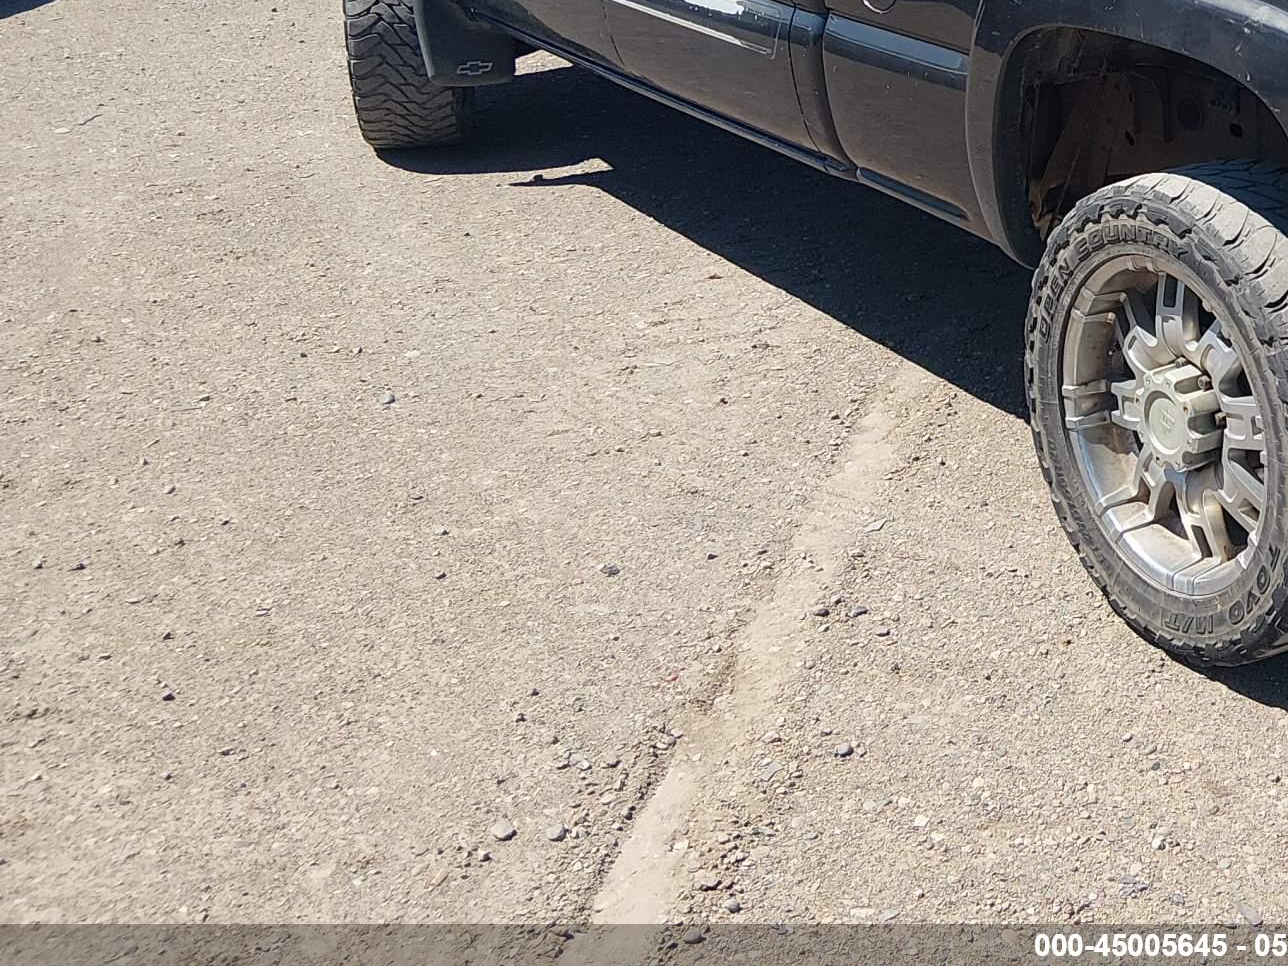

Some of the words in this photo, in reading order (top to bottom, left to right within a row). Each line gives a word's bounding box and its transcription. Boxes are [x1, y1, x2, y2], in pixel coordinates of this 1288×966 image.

[1039, 258, 1074, 344] OPEN
[1074, 224, 1188, 261] COUNTRY
[1227, 545, 1281, 626] TOYO
